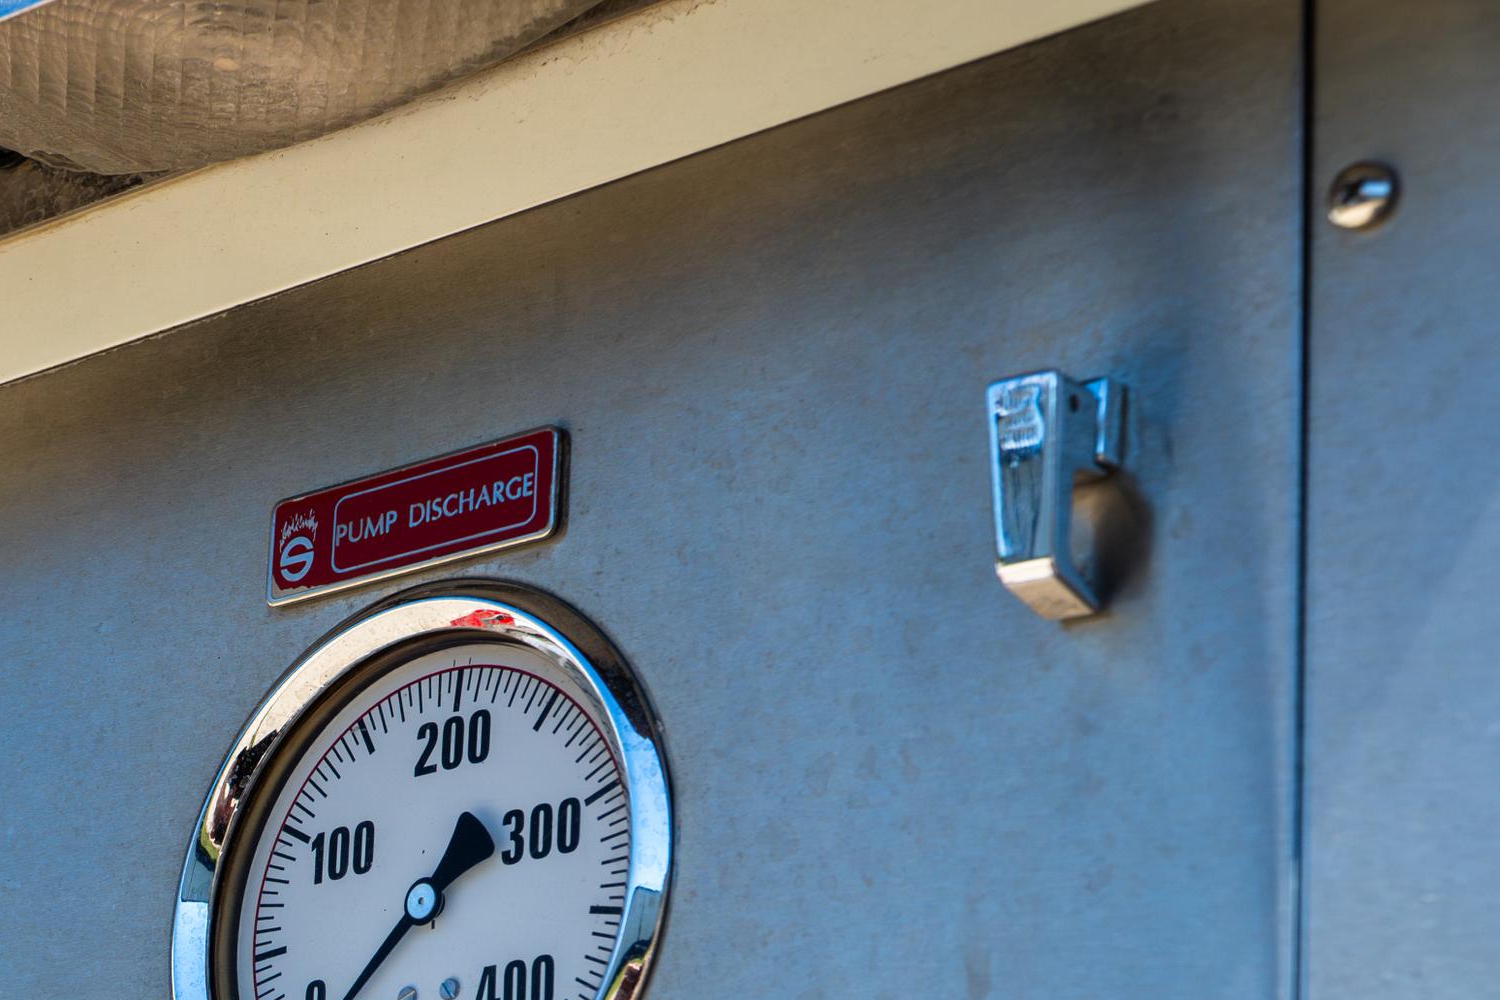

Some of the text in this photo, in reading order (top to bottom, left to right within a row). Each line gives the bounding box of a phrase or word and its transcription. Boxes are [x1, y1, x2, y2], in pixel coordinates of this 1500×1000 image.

[336, 472, 534, 546] PUMP DISCHARGE
[414, 710, 491, 777] 200
[311, 821, 375, 885] 100
[502, 797, 581, 865] 300
